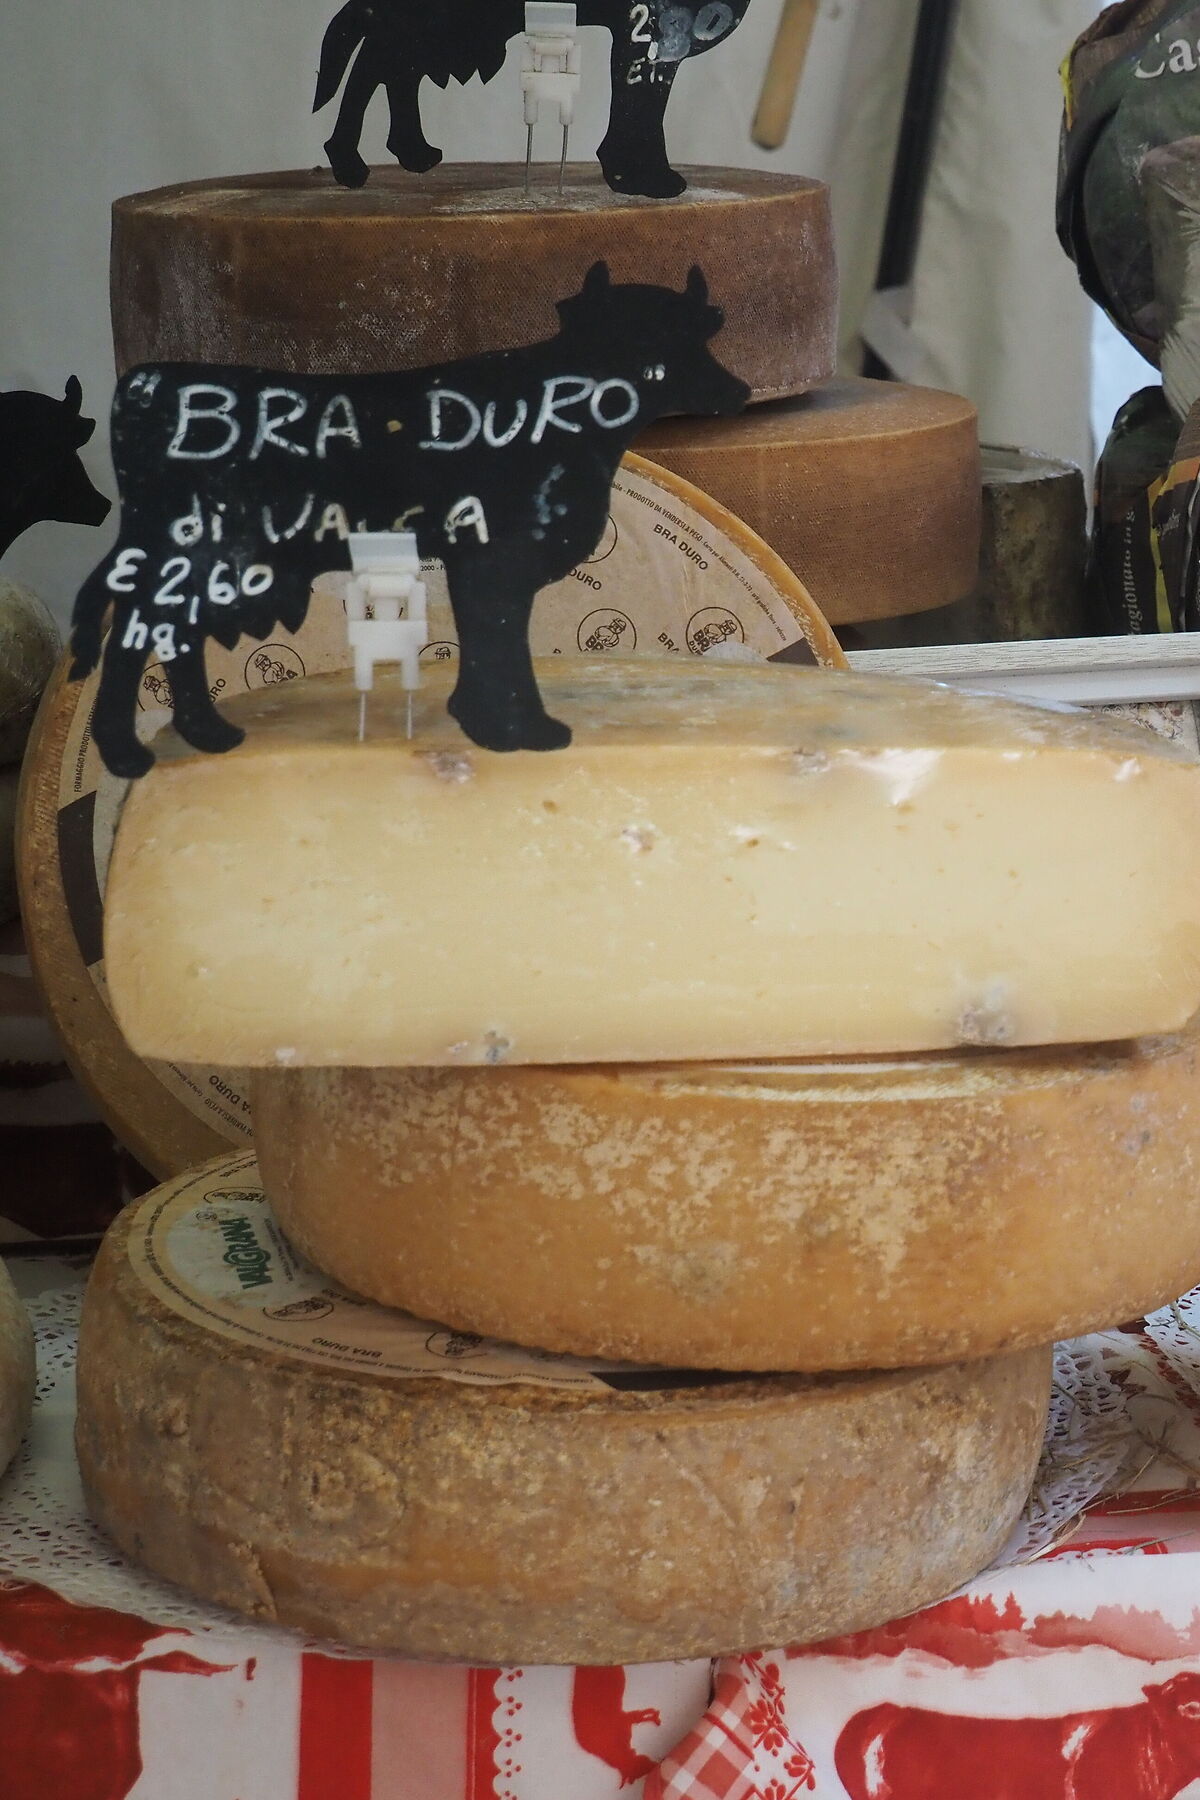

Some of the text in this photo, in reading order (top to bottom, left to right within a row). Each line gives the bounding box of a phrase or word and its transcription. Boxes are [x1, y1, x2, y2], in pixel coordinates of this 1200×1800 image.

[626, 489, 655, 508] PRODOTTO
[171, 494, 489, 546] di VACA
[653, 523, 708, 571] BRA DURO
[1121, 550, 1143, 634] agionato
[74, 756, 86, 793] FORMAGGIO
[209, 1075, 241, 1105] DURO
[312, 1337, 349, 1351] DURO
